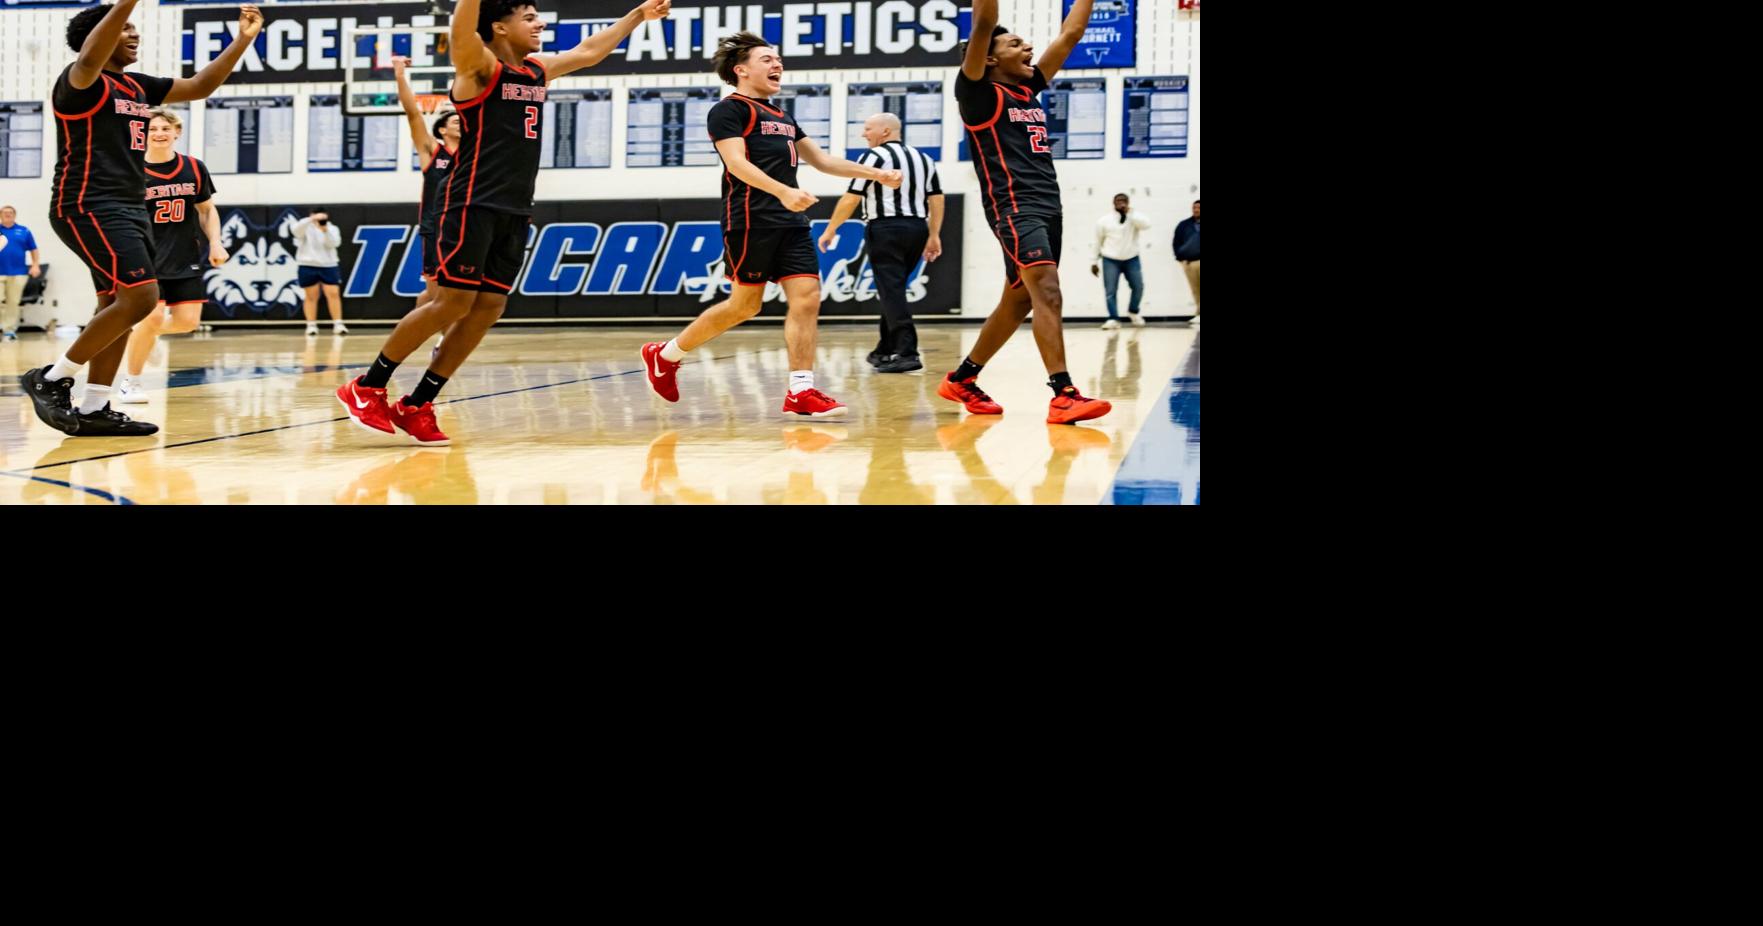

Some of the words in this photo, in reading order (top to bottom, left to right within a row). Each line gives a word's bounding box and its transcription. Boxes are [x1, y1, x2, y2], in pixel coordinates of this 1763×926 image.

[626, 0, 959, 61] ATHLETICS
[1078, 33, 1121, 43] URNETT
[129, 120, 146, 151] 15
[525, 106, 539, 139] 2
[154, 199, 185, 223] 20
